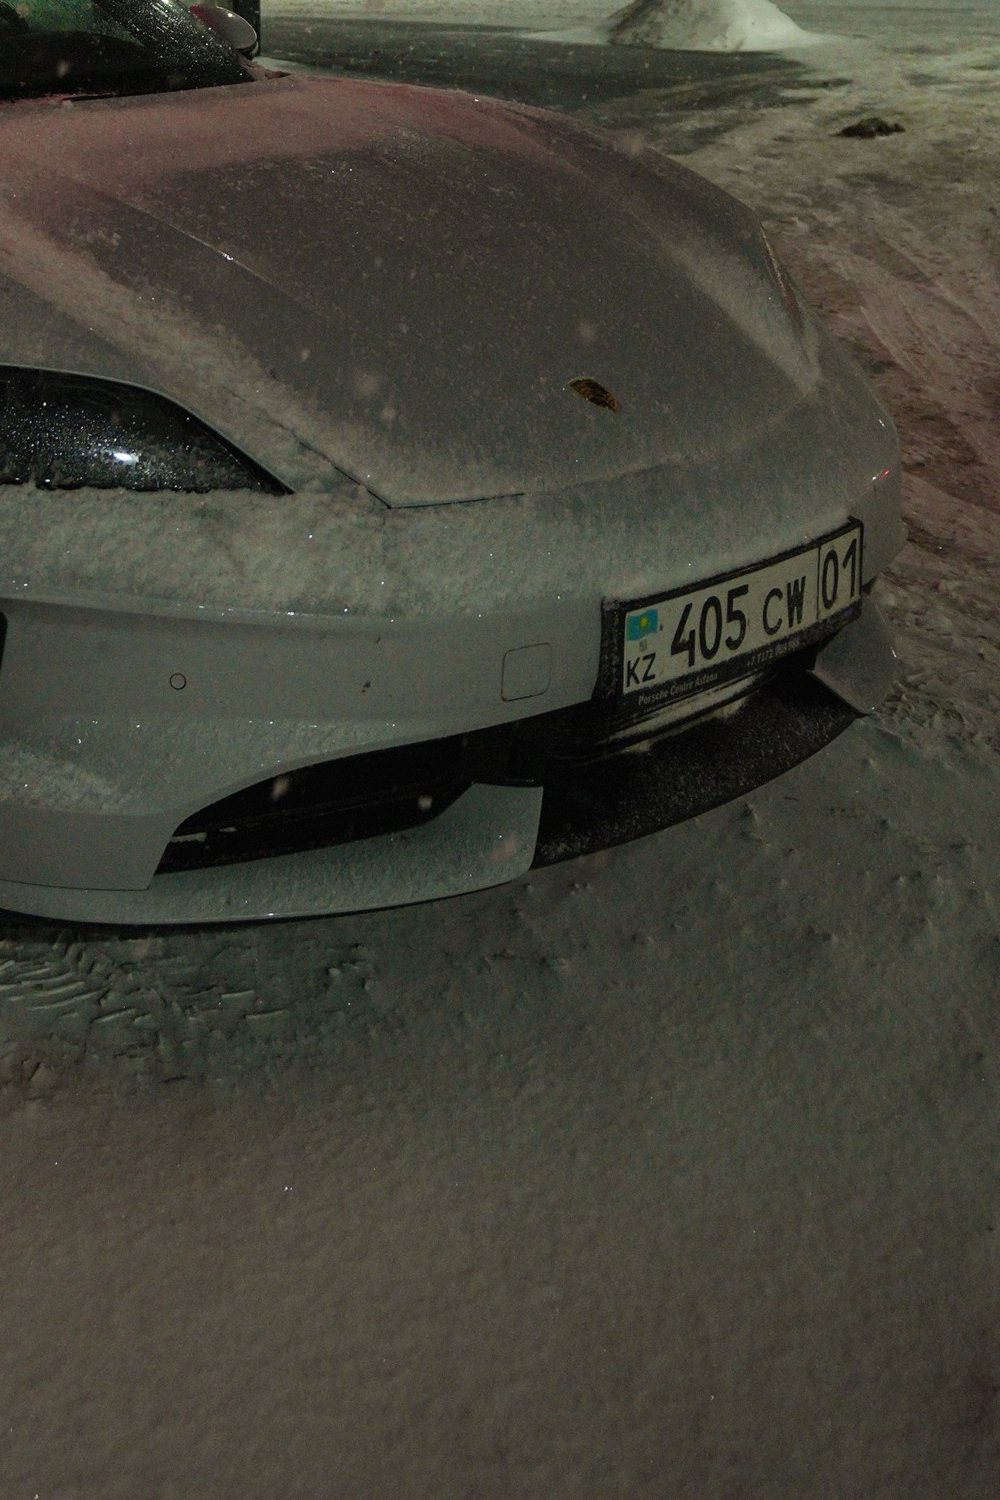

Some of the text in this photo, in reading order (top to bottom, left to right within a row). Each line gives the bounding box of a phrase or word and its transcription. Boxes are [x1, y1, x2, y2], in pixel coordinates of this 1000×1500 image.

[671, 538, 857, 667] 405 CW 01
[626, 652, 656, 687] KZ
